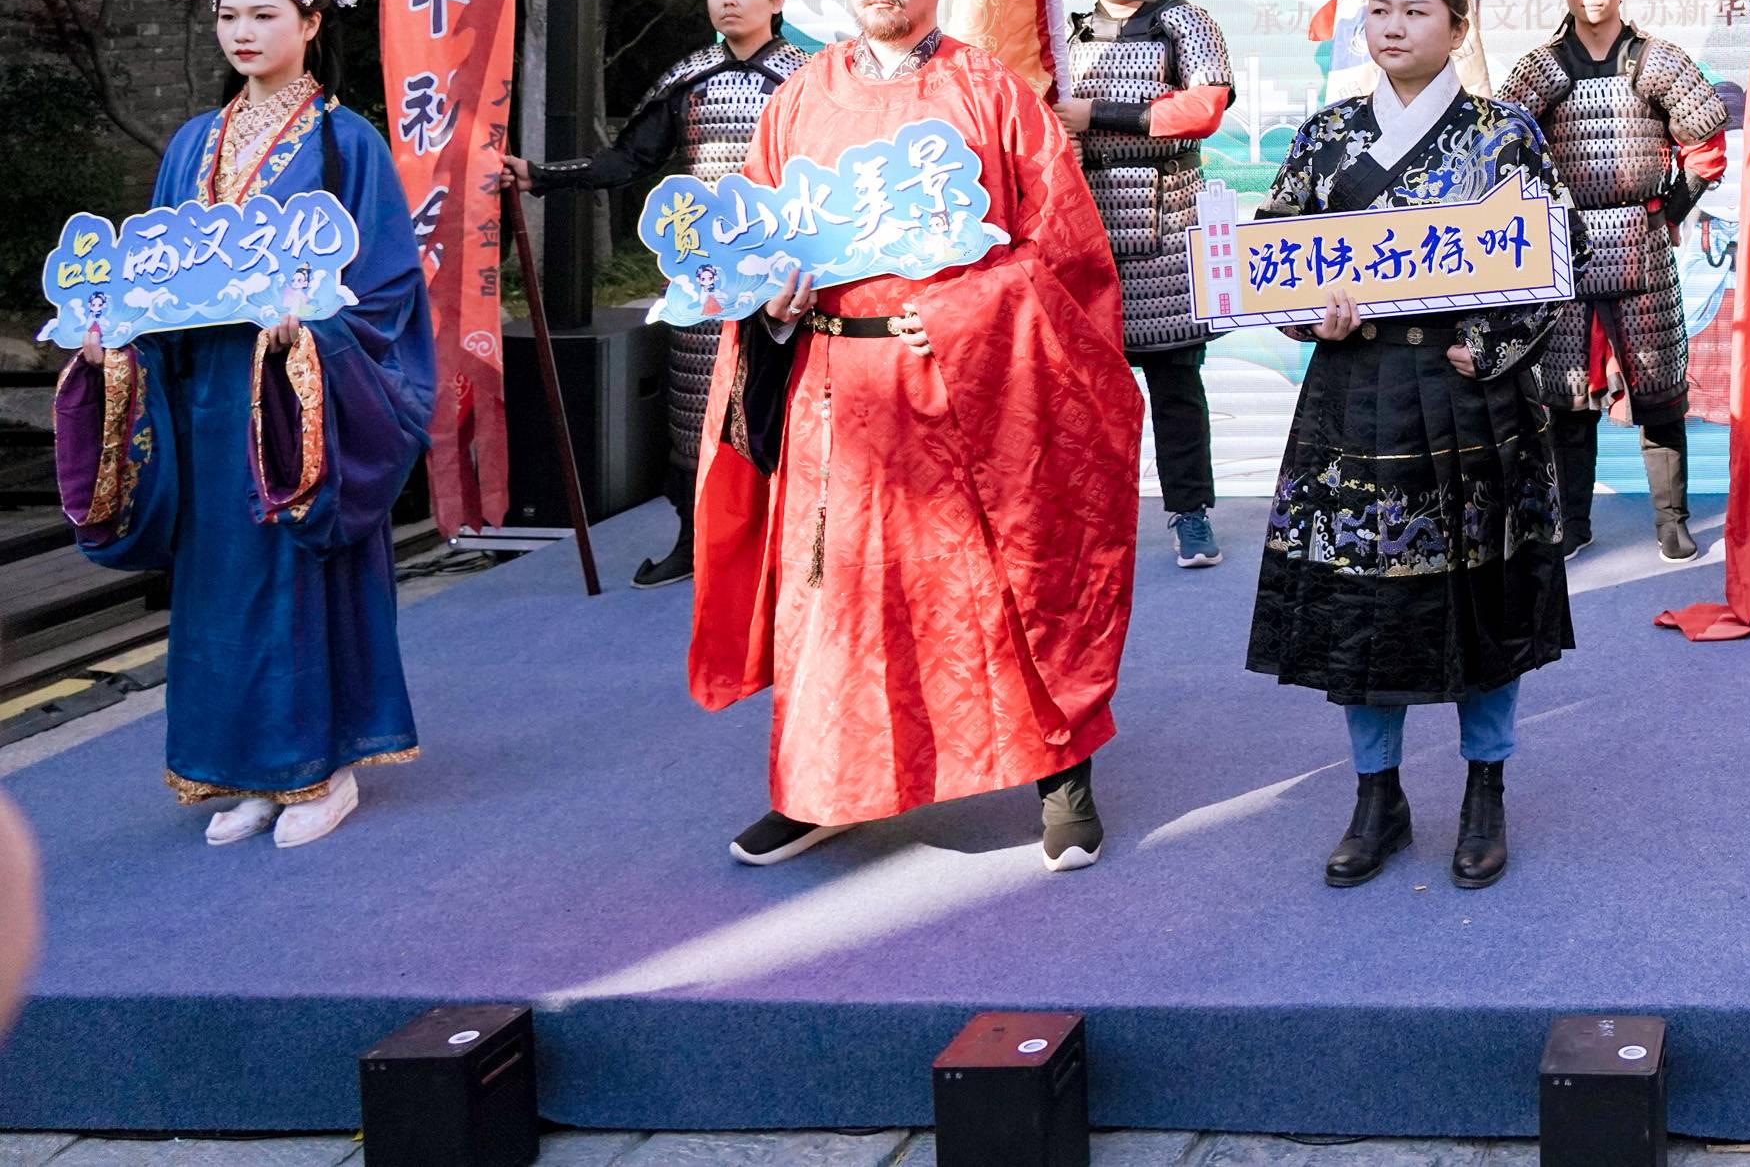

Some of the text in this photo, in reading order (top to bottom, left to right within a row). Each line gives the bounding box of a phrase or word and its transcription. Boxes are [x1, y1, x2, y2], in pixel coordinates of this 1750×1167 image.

[655, 134, 973, 264] 赏山水美景
[57, 206, 342, 288] 品两汉文化
[1248, 216, 1532, 291] 游快乐徐州
